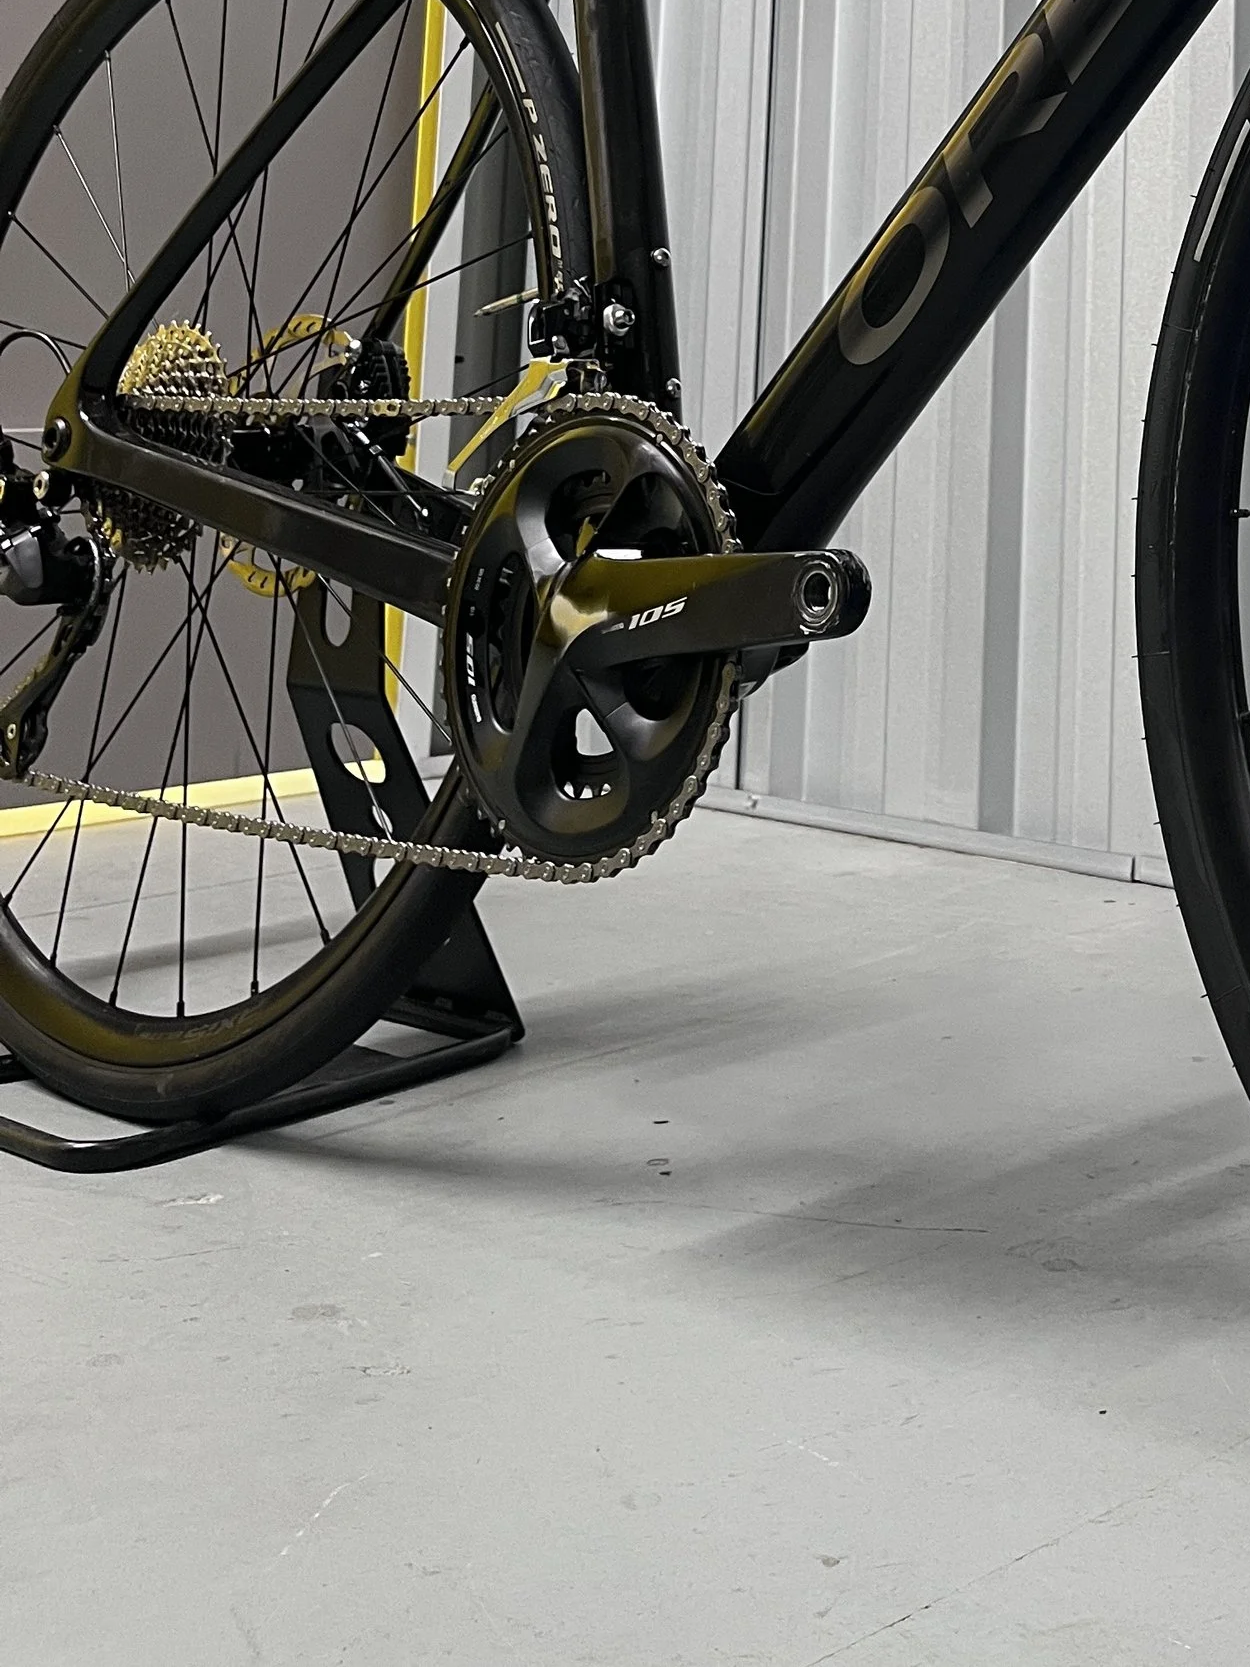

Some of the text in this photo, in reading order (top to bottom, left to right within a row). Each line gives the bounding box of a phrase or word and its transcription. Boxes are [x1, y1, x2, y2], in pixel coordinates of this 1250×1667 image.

[521, 96, 540, 125] P
[531, 132, 564, 260] ZERO
[627, 595, 689, 632] 105
